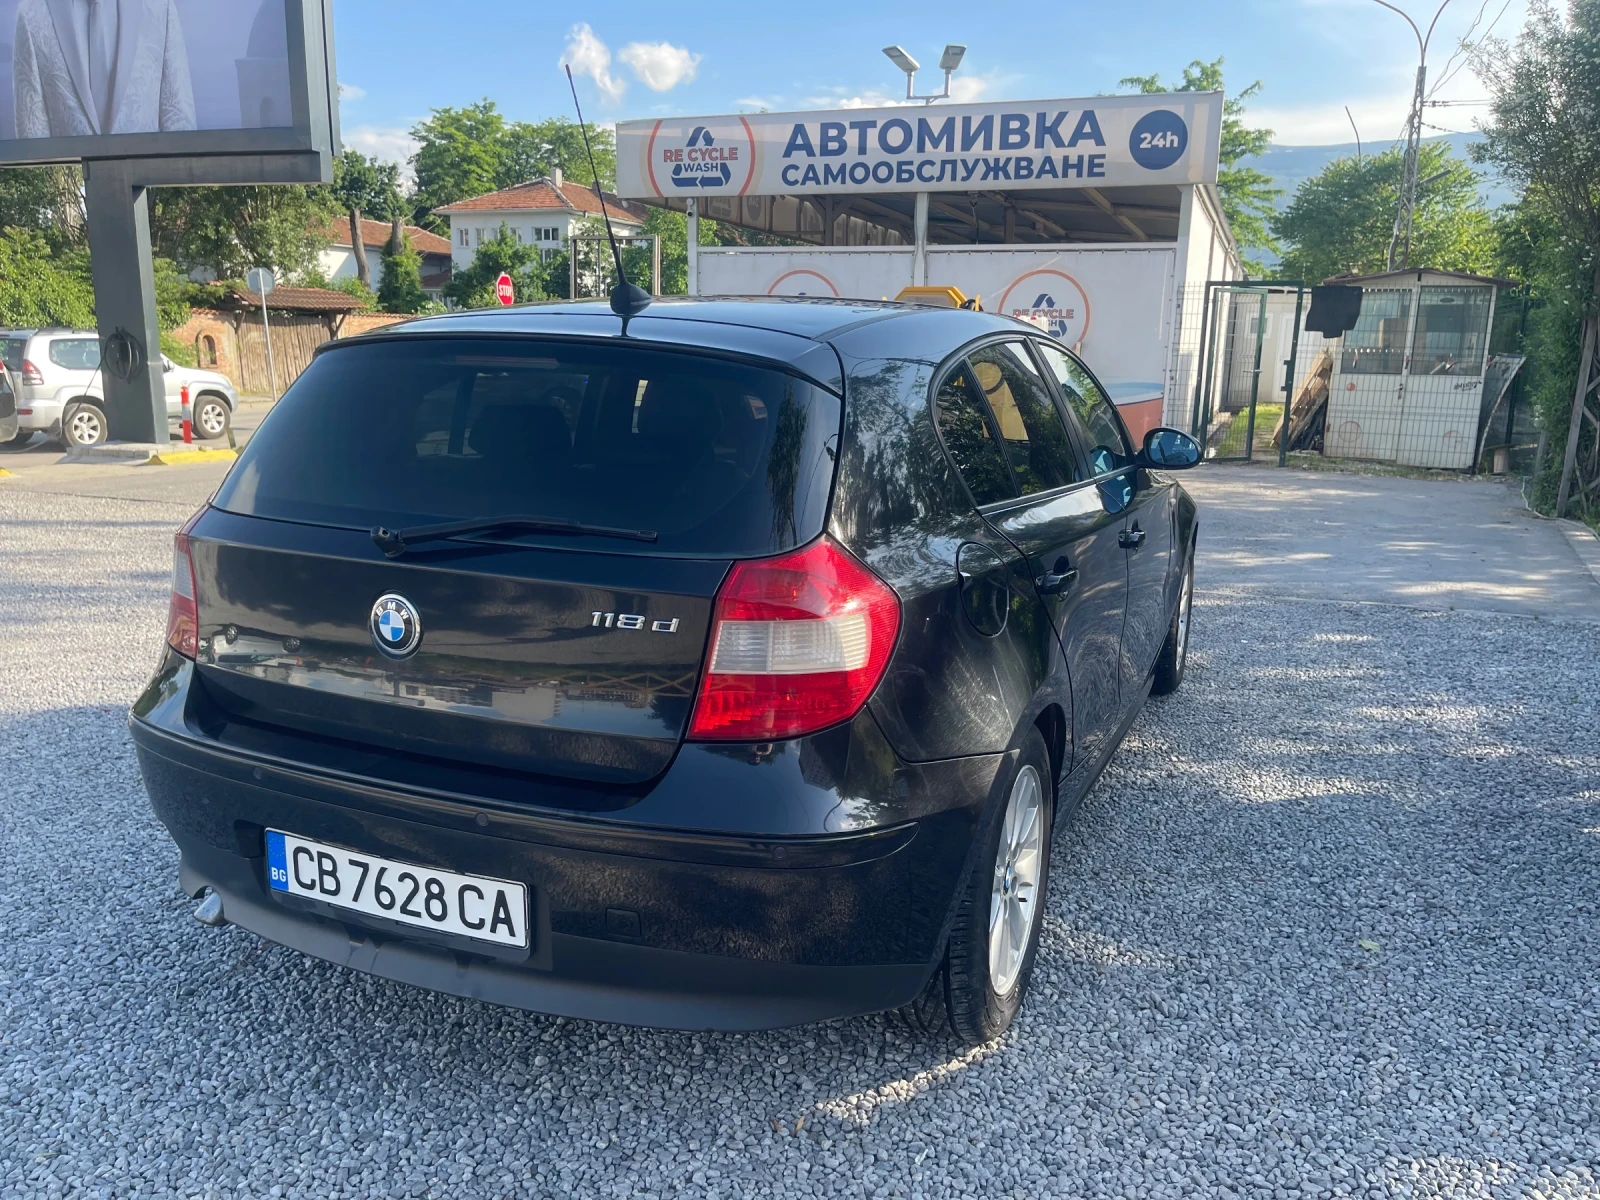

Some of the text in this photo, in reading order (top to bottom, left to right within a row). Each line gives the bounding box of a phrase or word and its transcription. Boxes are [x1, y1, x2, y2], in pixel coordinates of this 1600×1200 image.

[782, 110, 1106, 158] АВТОМИВКА
[1139, 131, 1179, 149] 24h
[663, 147, 739, 163] RE CYCLE
[683, 162, 719, 173] WASH
[781, 154, 1106, 187] САМООБСЛУЖВАНЕ
[1032, 309, 1074, 319] CYCLE
[375, 601, 409, 620] BMW
[271, 866, 287, 883] BG
